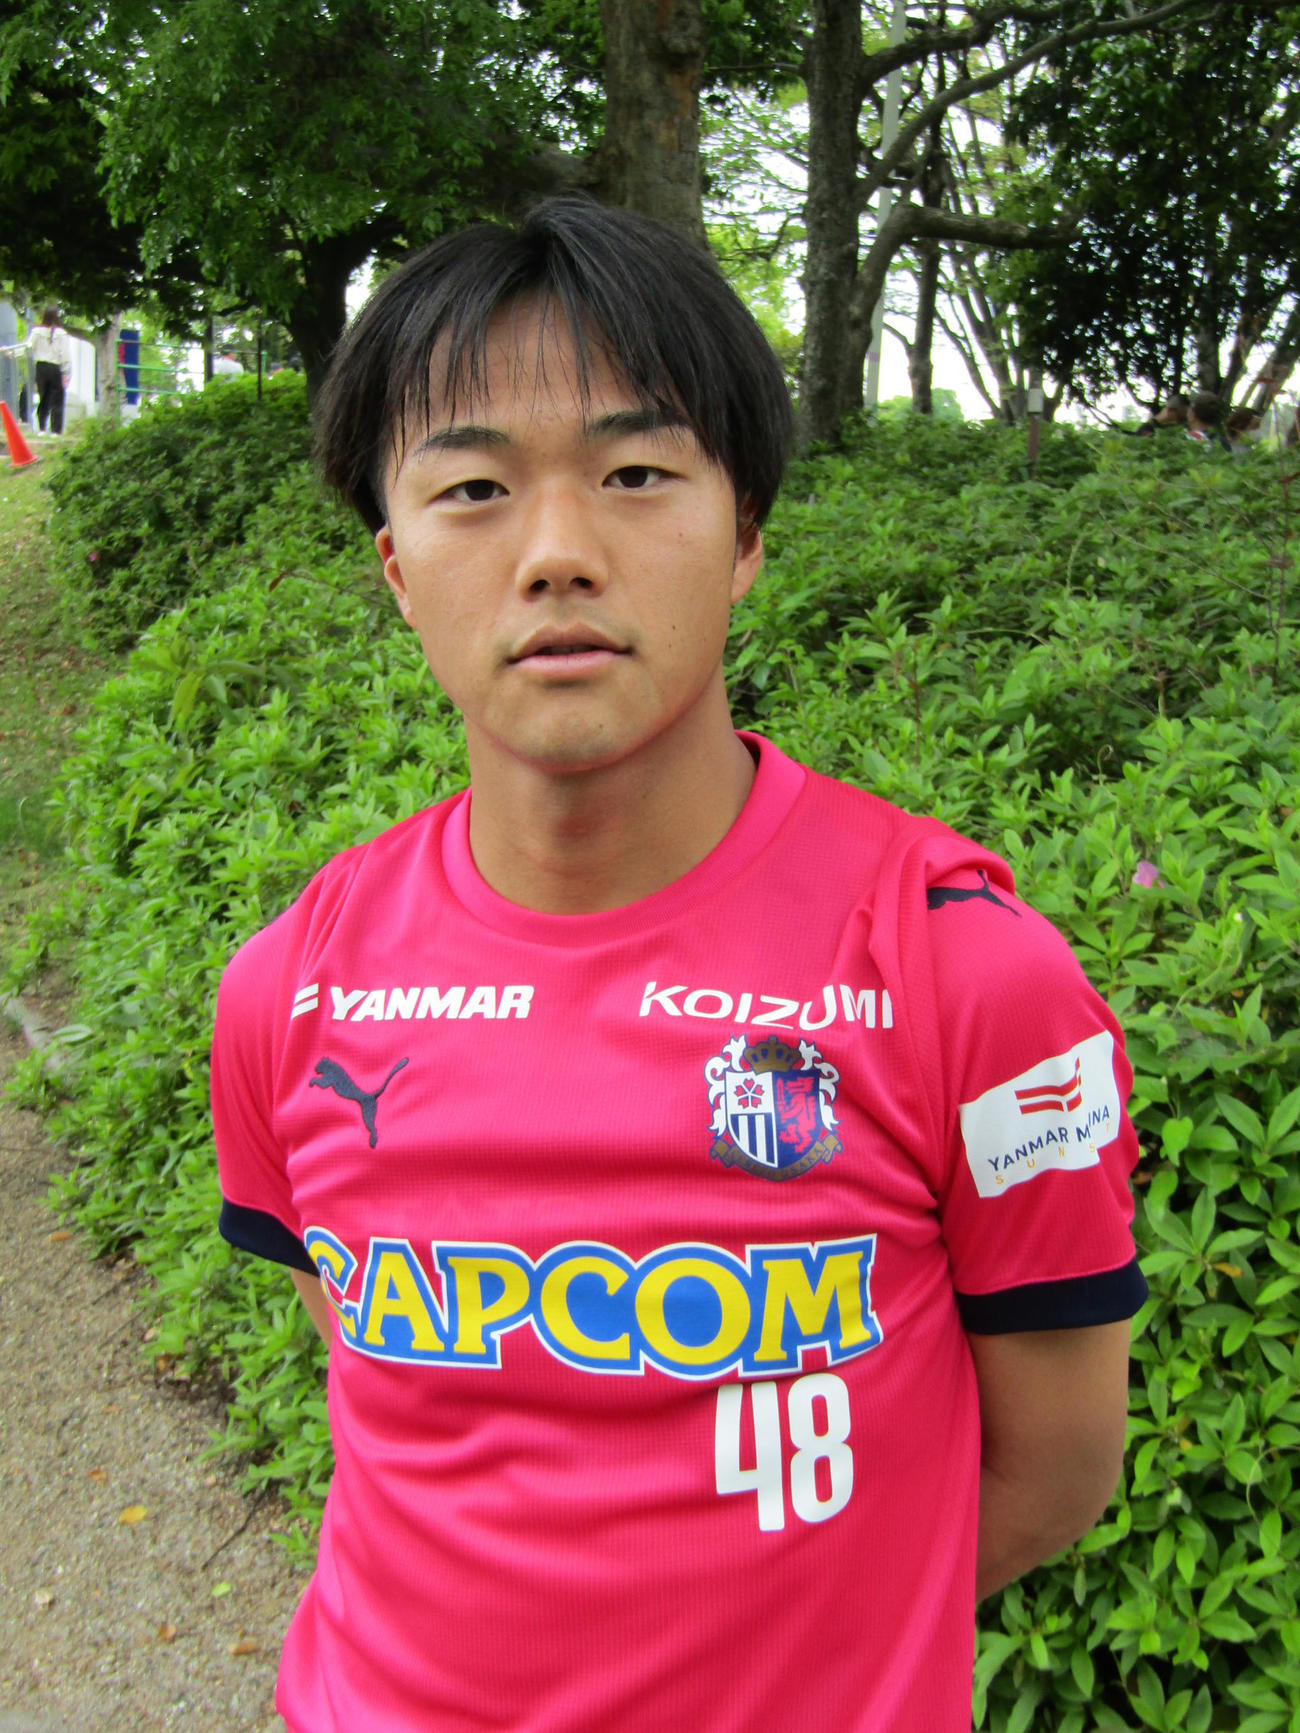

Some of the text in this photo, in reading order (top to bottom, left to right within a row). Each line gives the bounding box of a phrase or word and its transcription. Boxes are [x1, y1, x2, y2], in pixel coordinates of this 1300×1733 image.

[330, 984, 534, 1020] YANMAR
[639, 981, 894, 1031] KOIZUMI
[987, 1126, 1069, 1172] YANMAR
[303, 1226, 884, 1381] CAPCOM
[714, 1373, 854, 1532] 48
